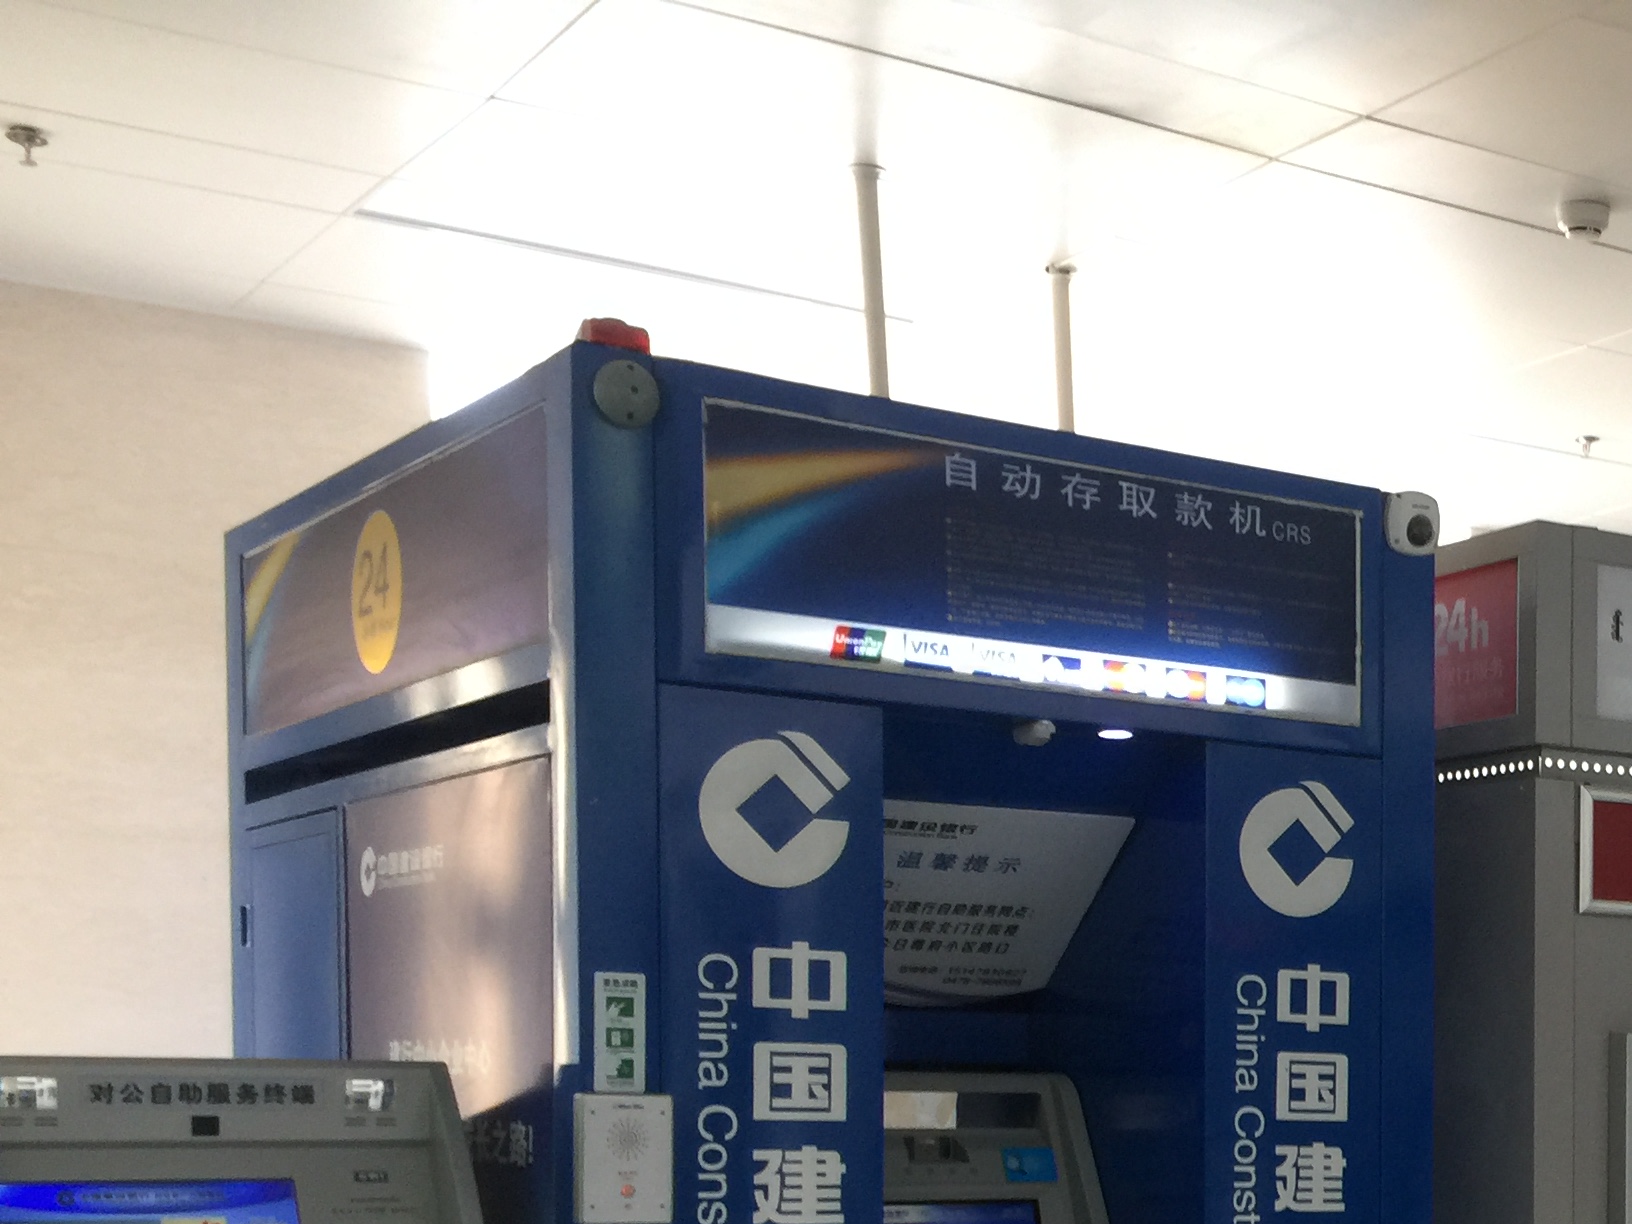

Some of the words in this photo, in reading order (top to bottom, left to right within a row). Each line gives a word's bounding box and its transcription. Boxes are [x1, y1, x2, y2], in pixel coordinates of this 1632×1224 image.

[944, 452, 1268, 537] 自动存取款机
[1272, 520, 1312, 546] CRS
[358, 541, 390, 618] 24
[911, 640, 950, 657] VISA
[896, 851, 1021, 874] 温馨提示
[696, 953, 738, 1090] China
[1235, 973, 1267, 1093] China
[90, 1082, 315, 1105] 对公自助服务终端
